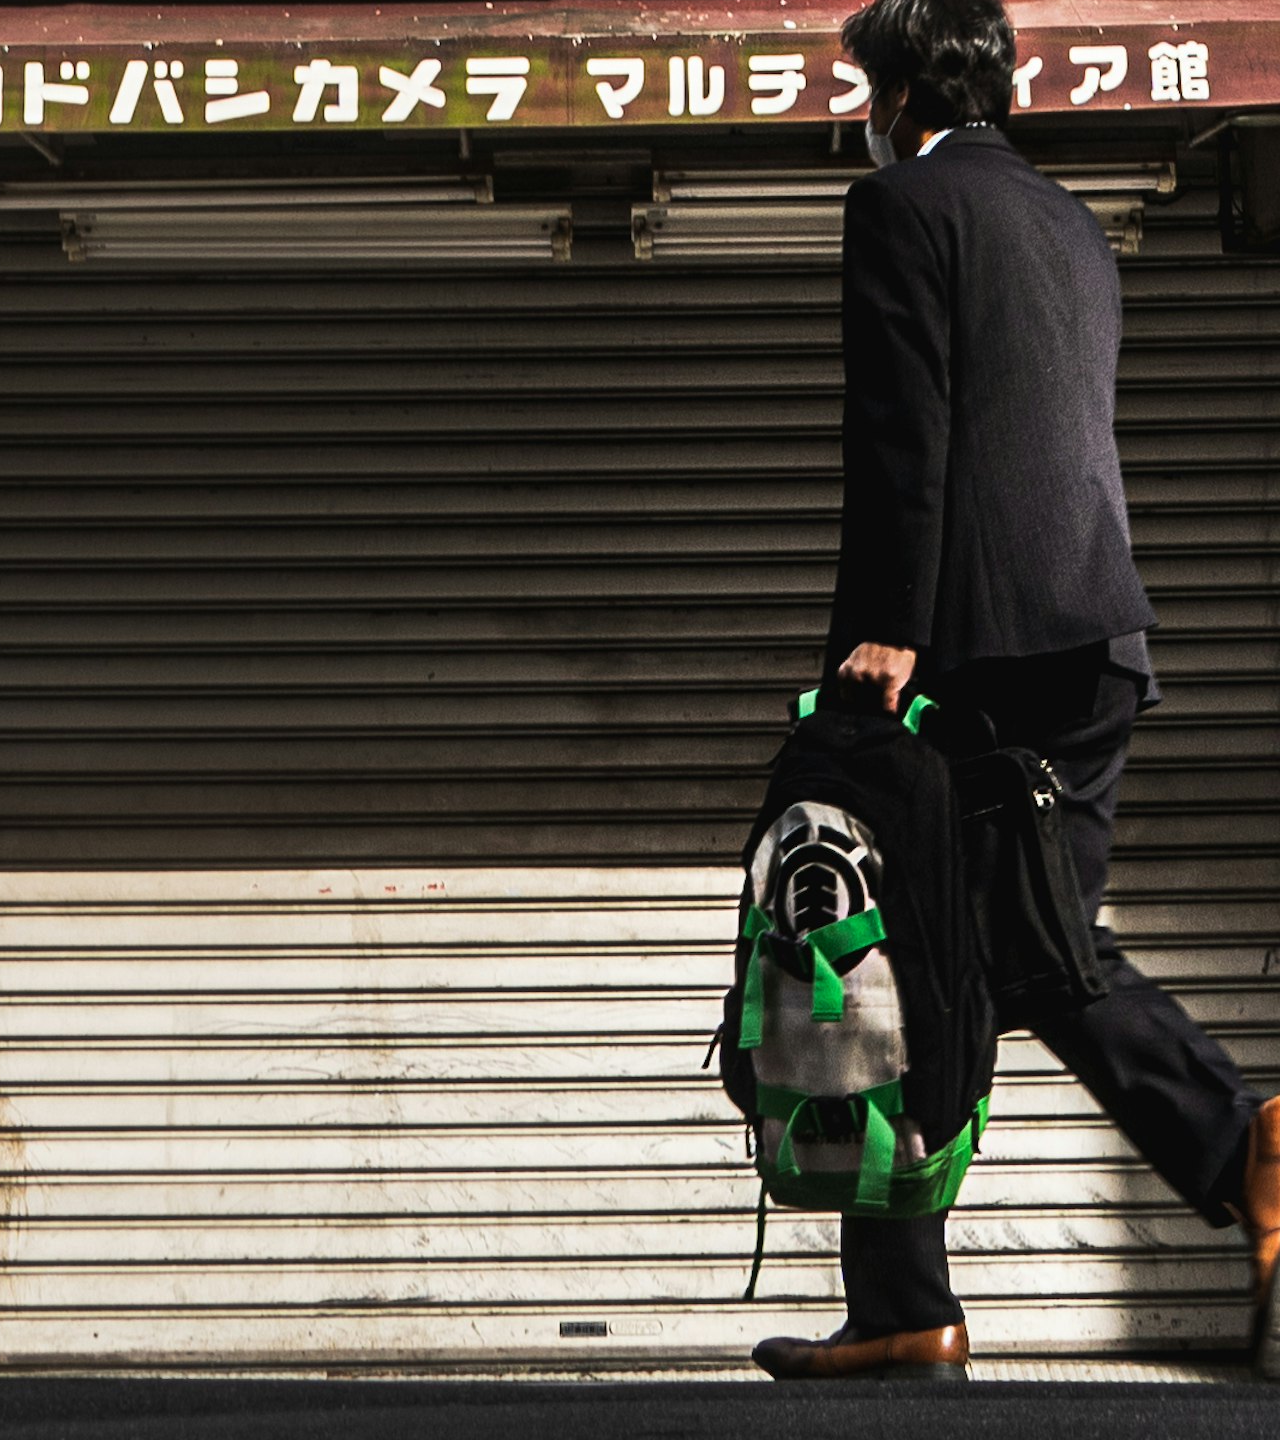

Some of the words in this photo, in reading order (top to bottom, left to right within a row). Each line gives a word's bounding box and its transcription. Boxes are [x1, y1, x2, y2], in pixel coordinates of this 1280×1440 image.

[586, 40, 1211, 120] マルチメィア館
